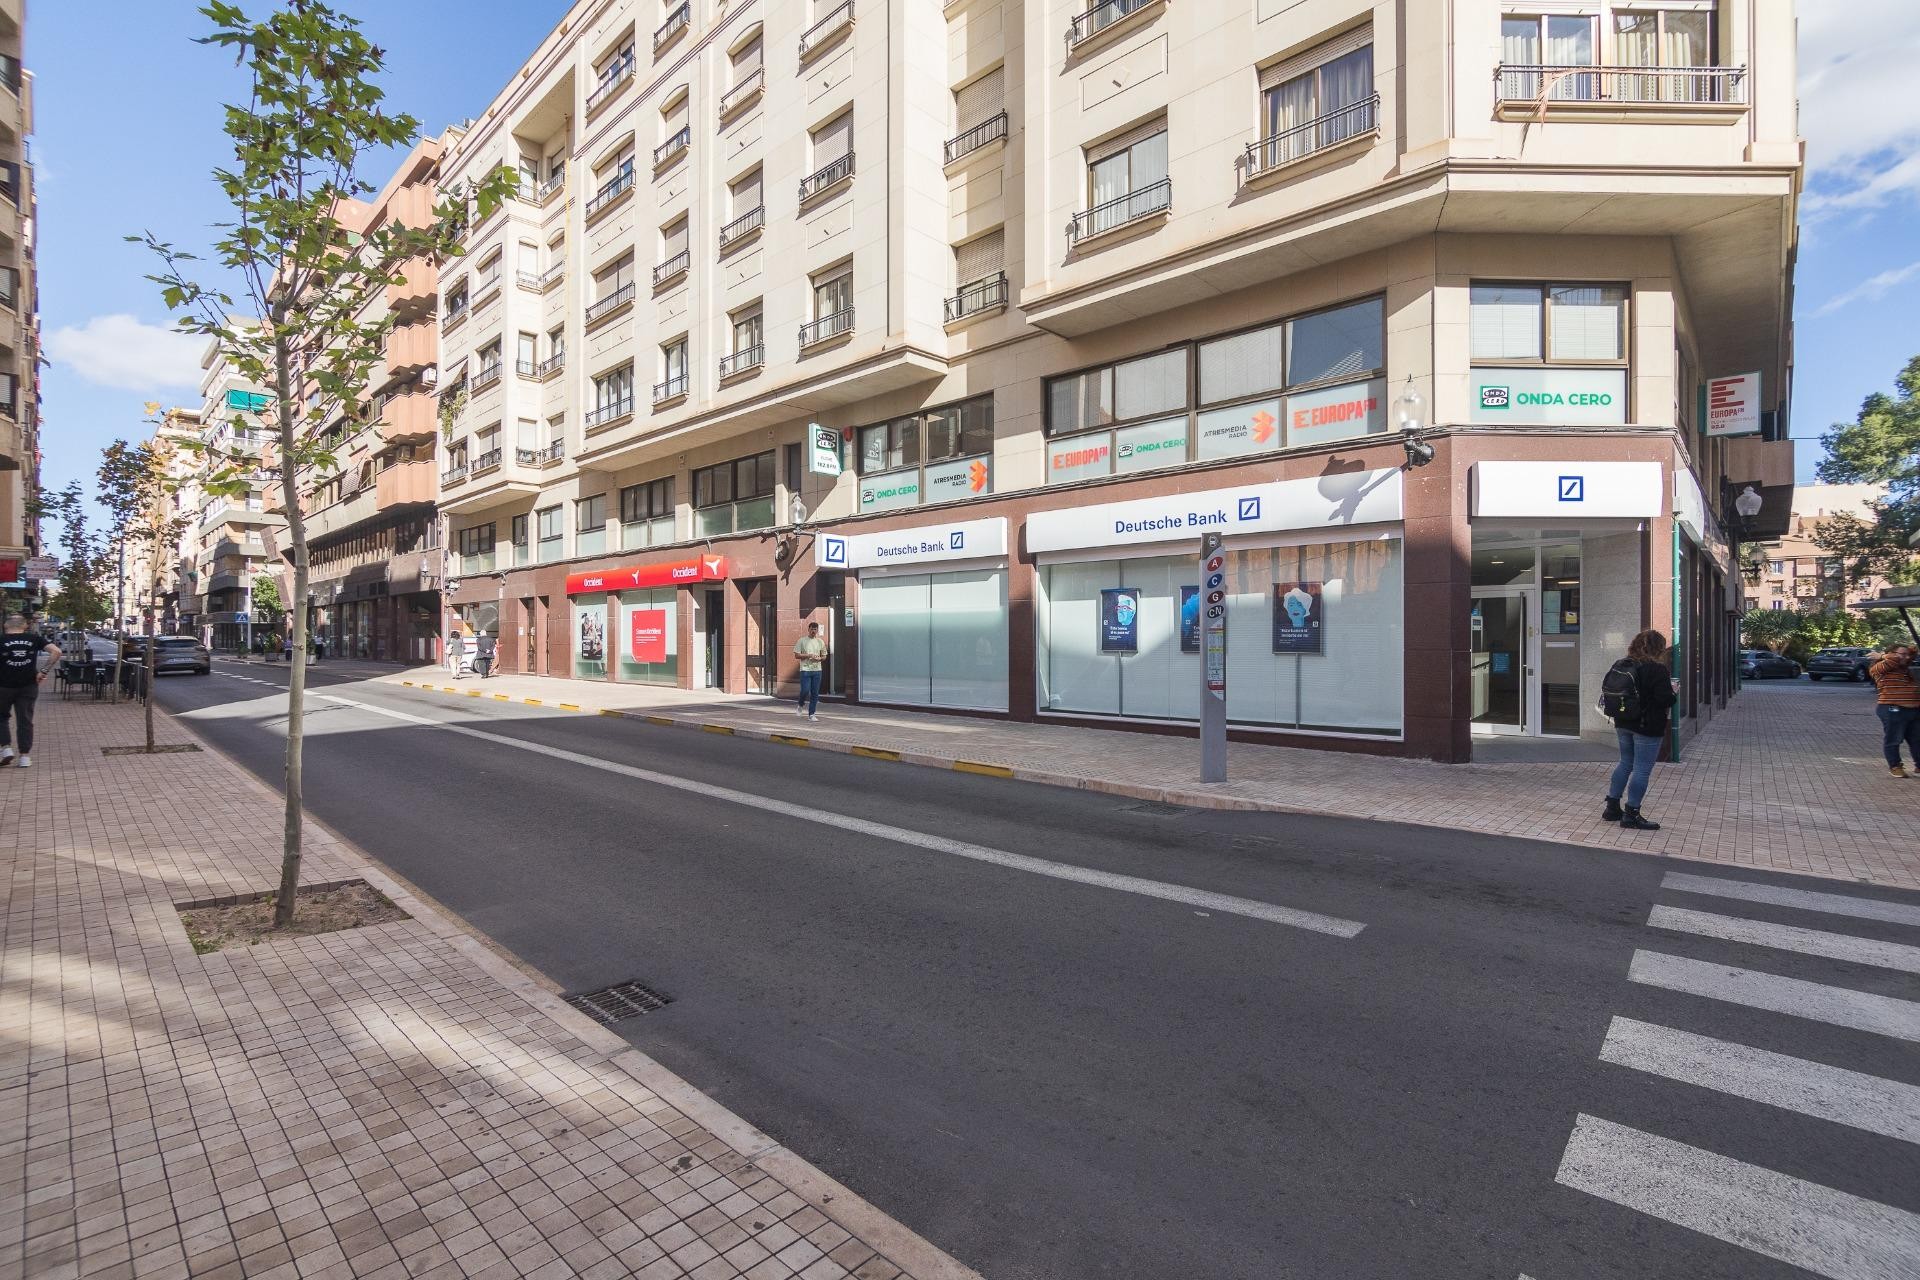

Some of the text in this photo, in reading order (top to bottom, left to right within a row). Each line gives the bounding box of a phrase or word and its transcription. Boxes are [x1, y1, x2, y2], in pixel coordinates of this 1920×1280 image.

[1517, 393, 1612, 406] ONDA CERO
[1311, 401, 1364, 426] EUROPA
[1711, 409, 1738, 418] EUROPA
[1203, 424, 1247, 438] ATRESMEDIA
[1228, 431, 1248, 439] RADIO
[1136, 443, 1161, 453] ONDA
[1065, 447, 1099, 468] EUROPA
[933, 473, 967, 485] ATRESMEDIA
[877, 489, 898, 499] ONDA
[898, 485, 918, 496] CERO
[1115, 510, 1228, 534] Deutsche Bank
[877, 541, 945, 557] Deutsche Bank
[1212, 559, 1219, 568] A
[672, 566, 698, 579] Occident
[583, 577, 603, 587] Occident
[1212, 576, 1218, 586] C
[1212, 593, 1219, 602] G
[1208, 606, 1222, 618] CN
[6, 659, 32, 667] TATTOO
